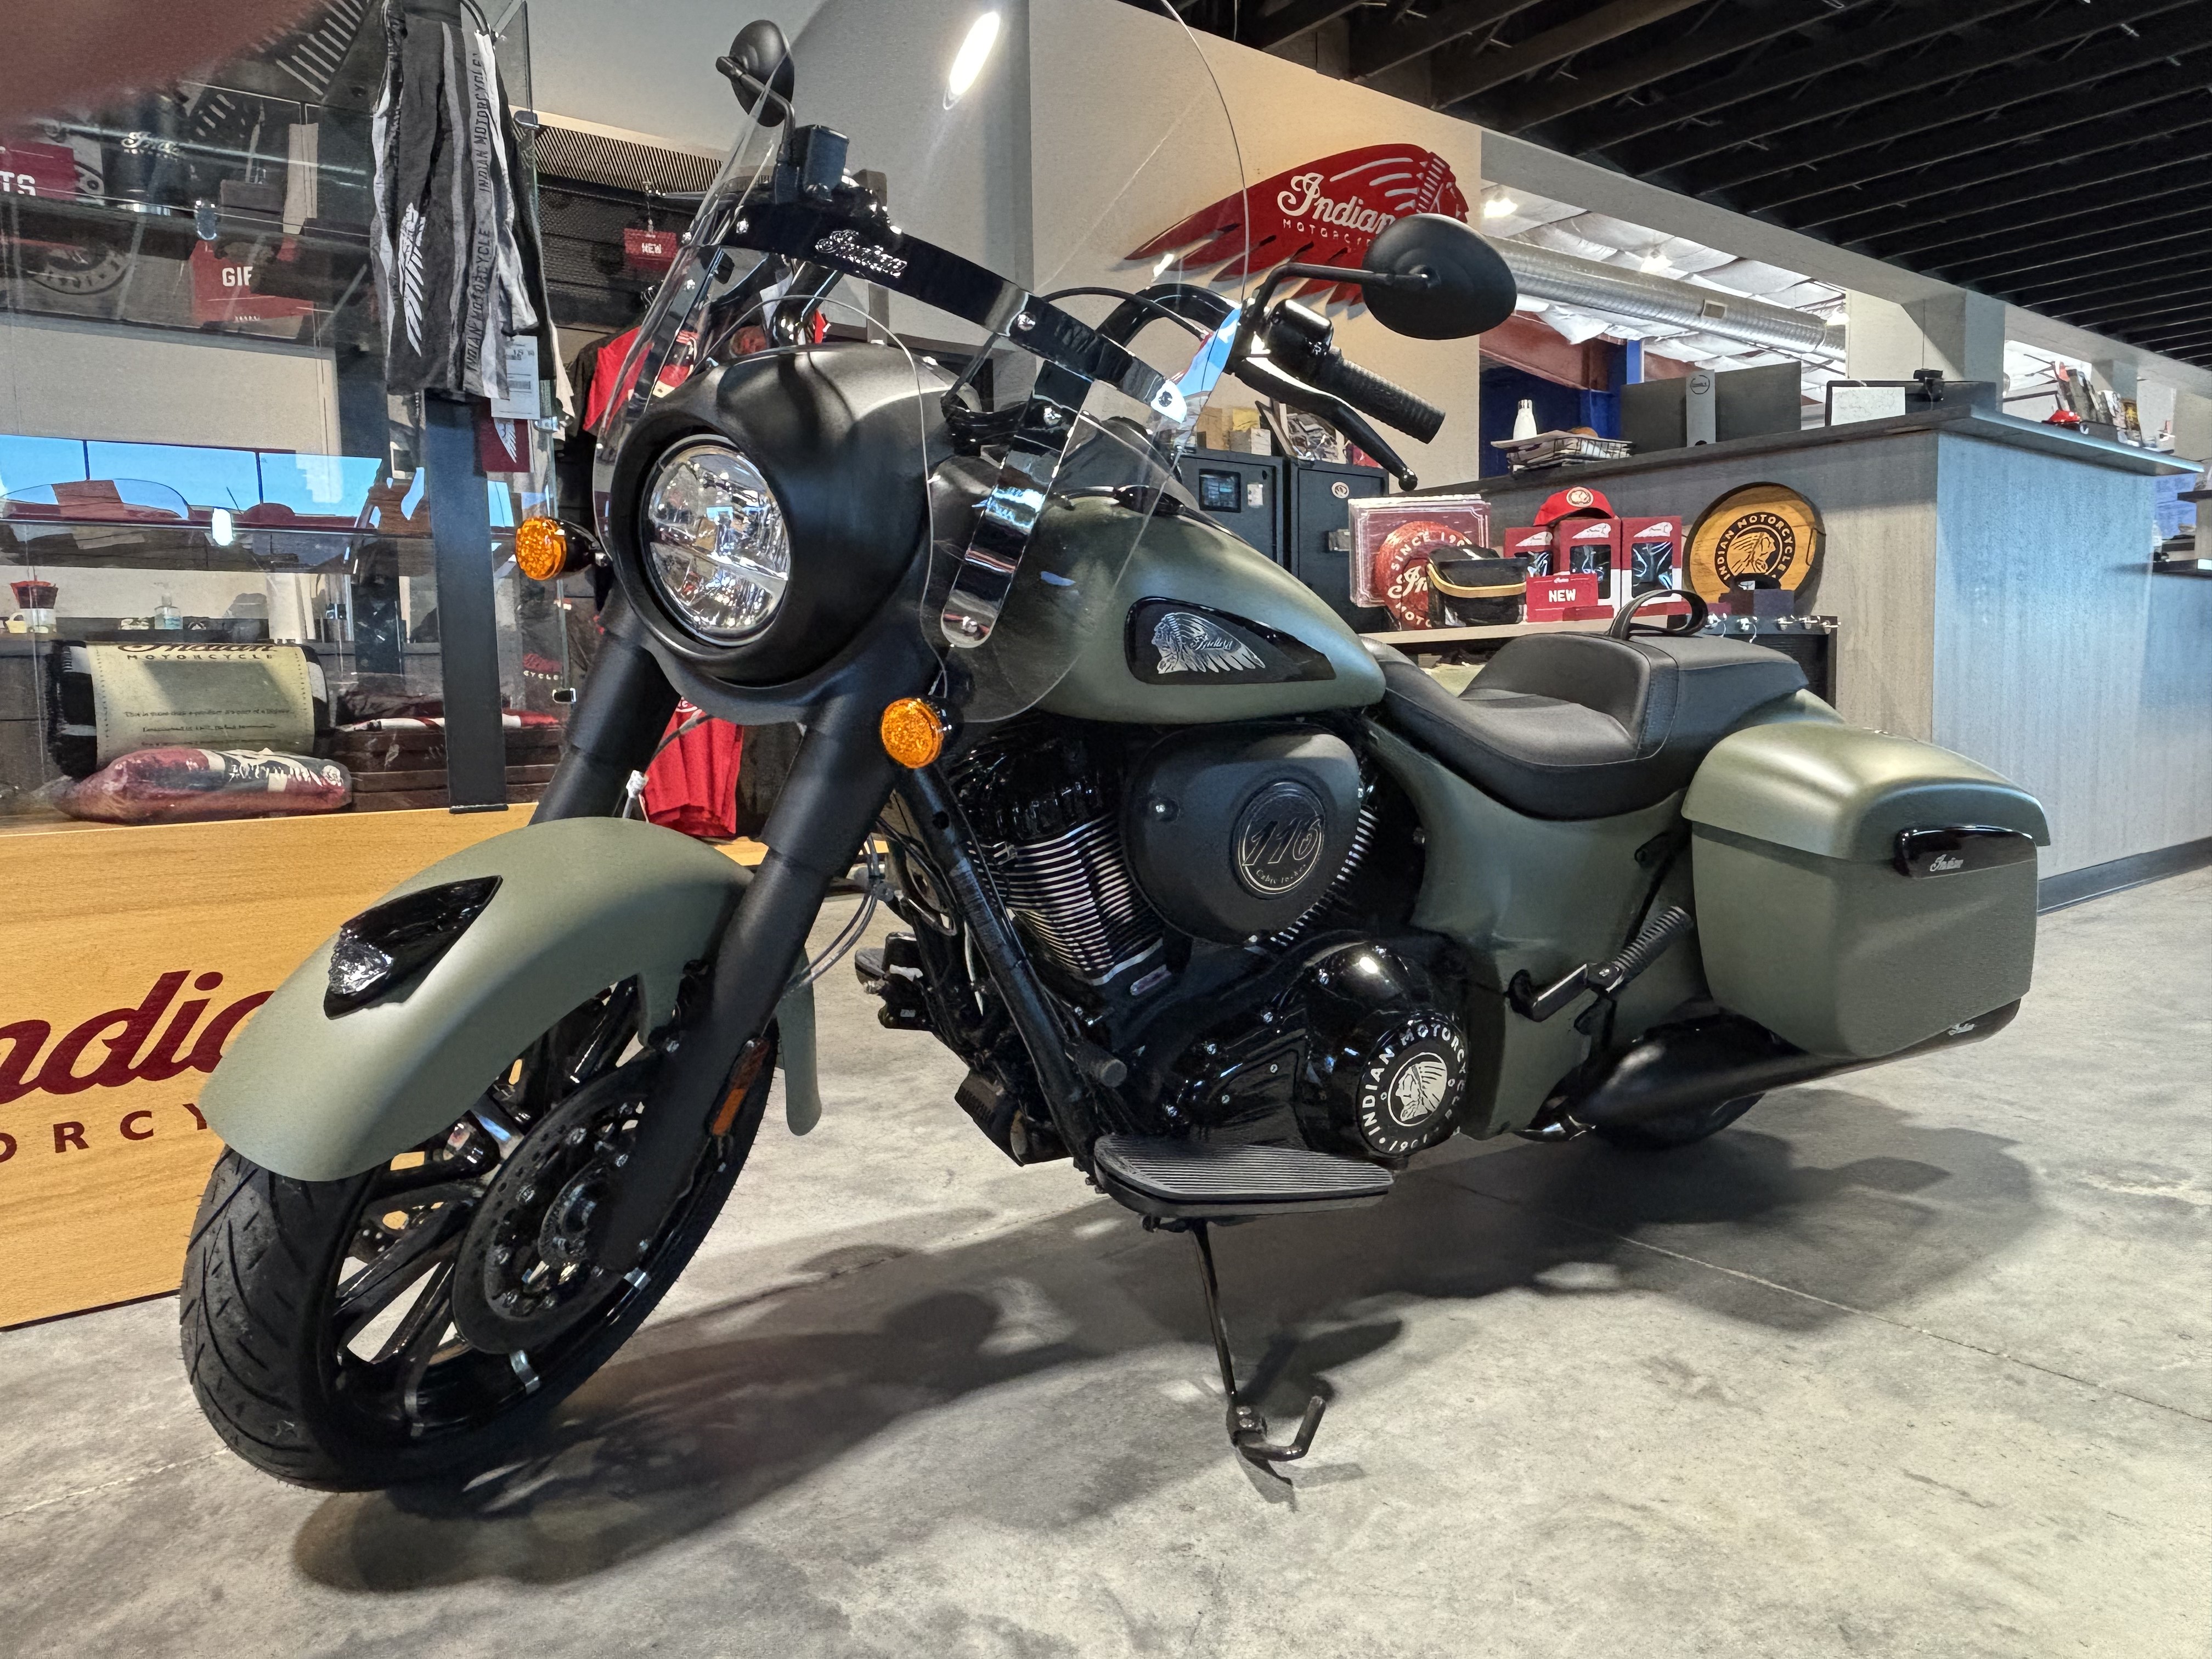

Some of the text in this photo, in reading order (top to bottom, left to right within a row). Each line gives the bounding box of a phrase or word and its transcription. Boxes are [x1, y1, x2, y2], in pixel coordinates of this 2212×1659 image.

[0, 171, 36, 196] TS
[1277, 172, 1396, 234] Indian
[641, 242, 662, 254] NEW
[1283, 218, 1372, 247] MOTORCY
[222, 266, 253, 287] GIF
[1391, 528, 1465, 571] SINCE 190
[1717, 530, 1735, 580] INDIAN
[1548, 589, 1576, 602] NEW
[523, 670, 559, 681] CYCLE
[1242, 815, 1322, 867] 116
[0, 969, 274, 1104] ndi
[1362, 1045, 1395, 1136] INDIAN
